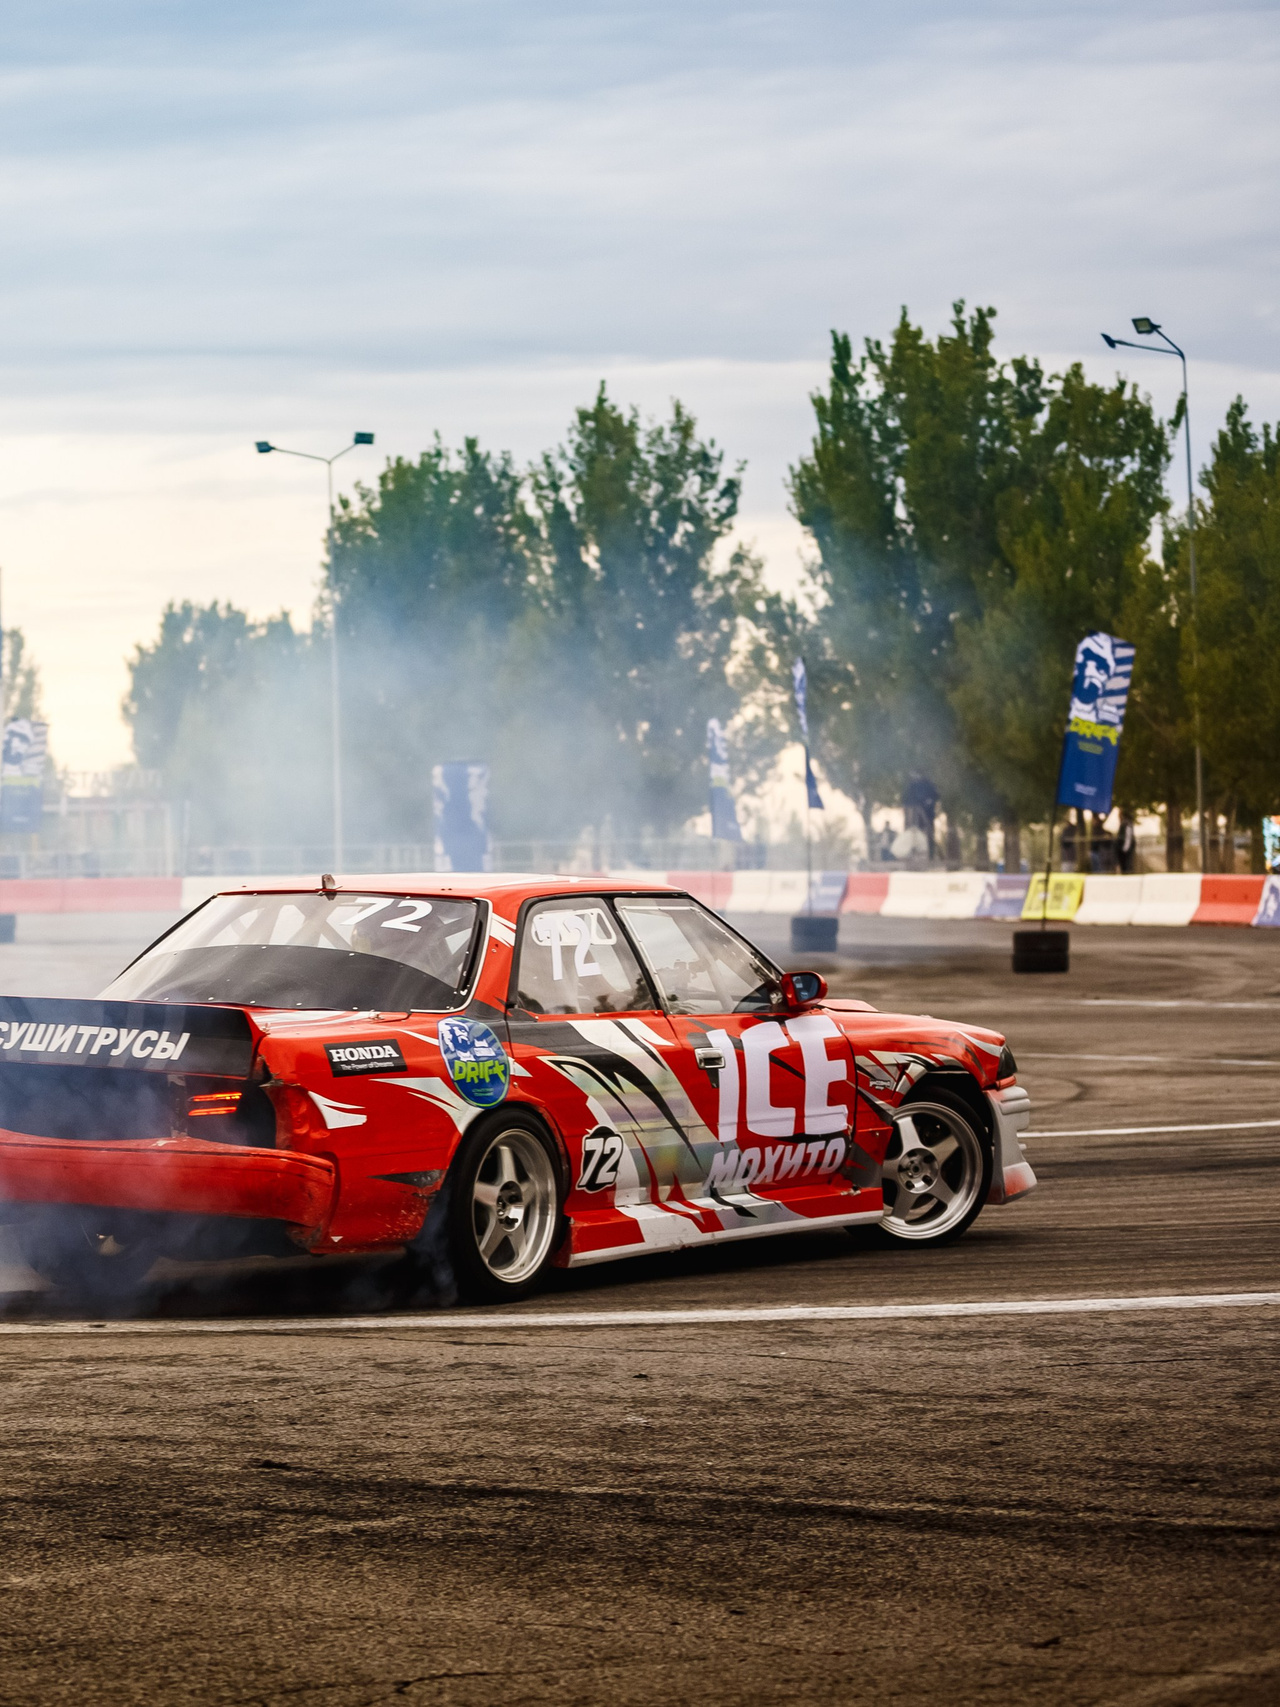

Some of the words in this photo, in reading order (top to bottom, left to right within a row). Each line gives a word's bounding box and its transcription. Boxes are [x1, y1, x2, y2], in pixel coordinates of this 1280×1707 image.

[339, 897, 433, 933] 72
[533, 916, 601, 981] 72
[329, 1045, 400, 1062] HONDA
[453, 1060, 506, 1084] DRIFT
[705, 1015, 849, 1144] ICE
[580, 1136, 622, 1187] 72
